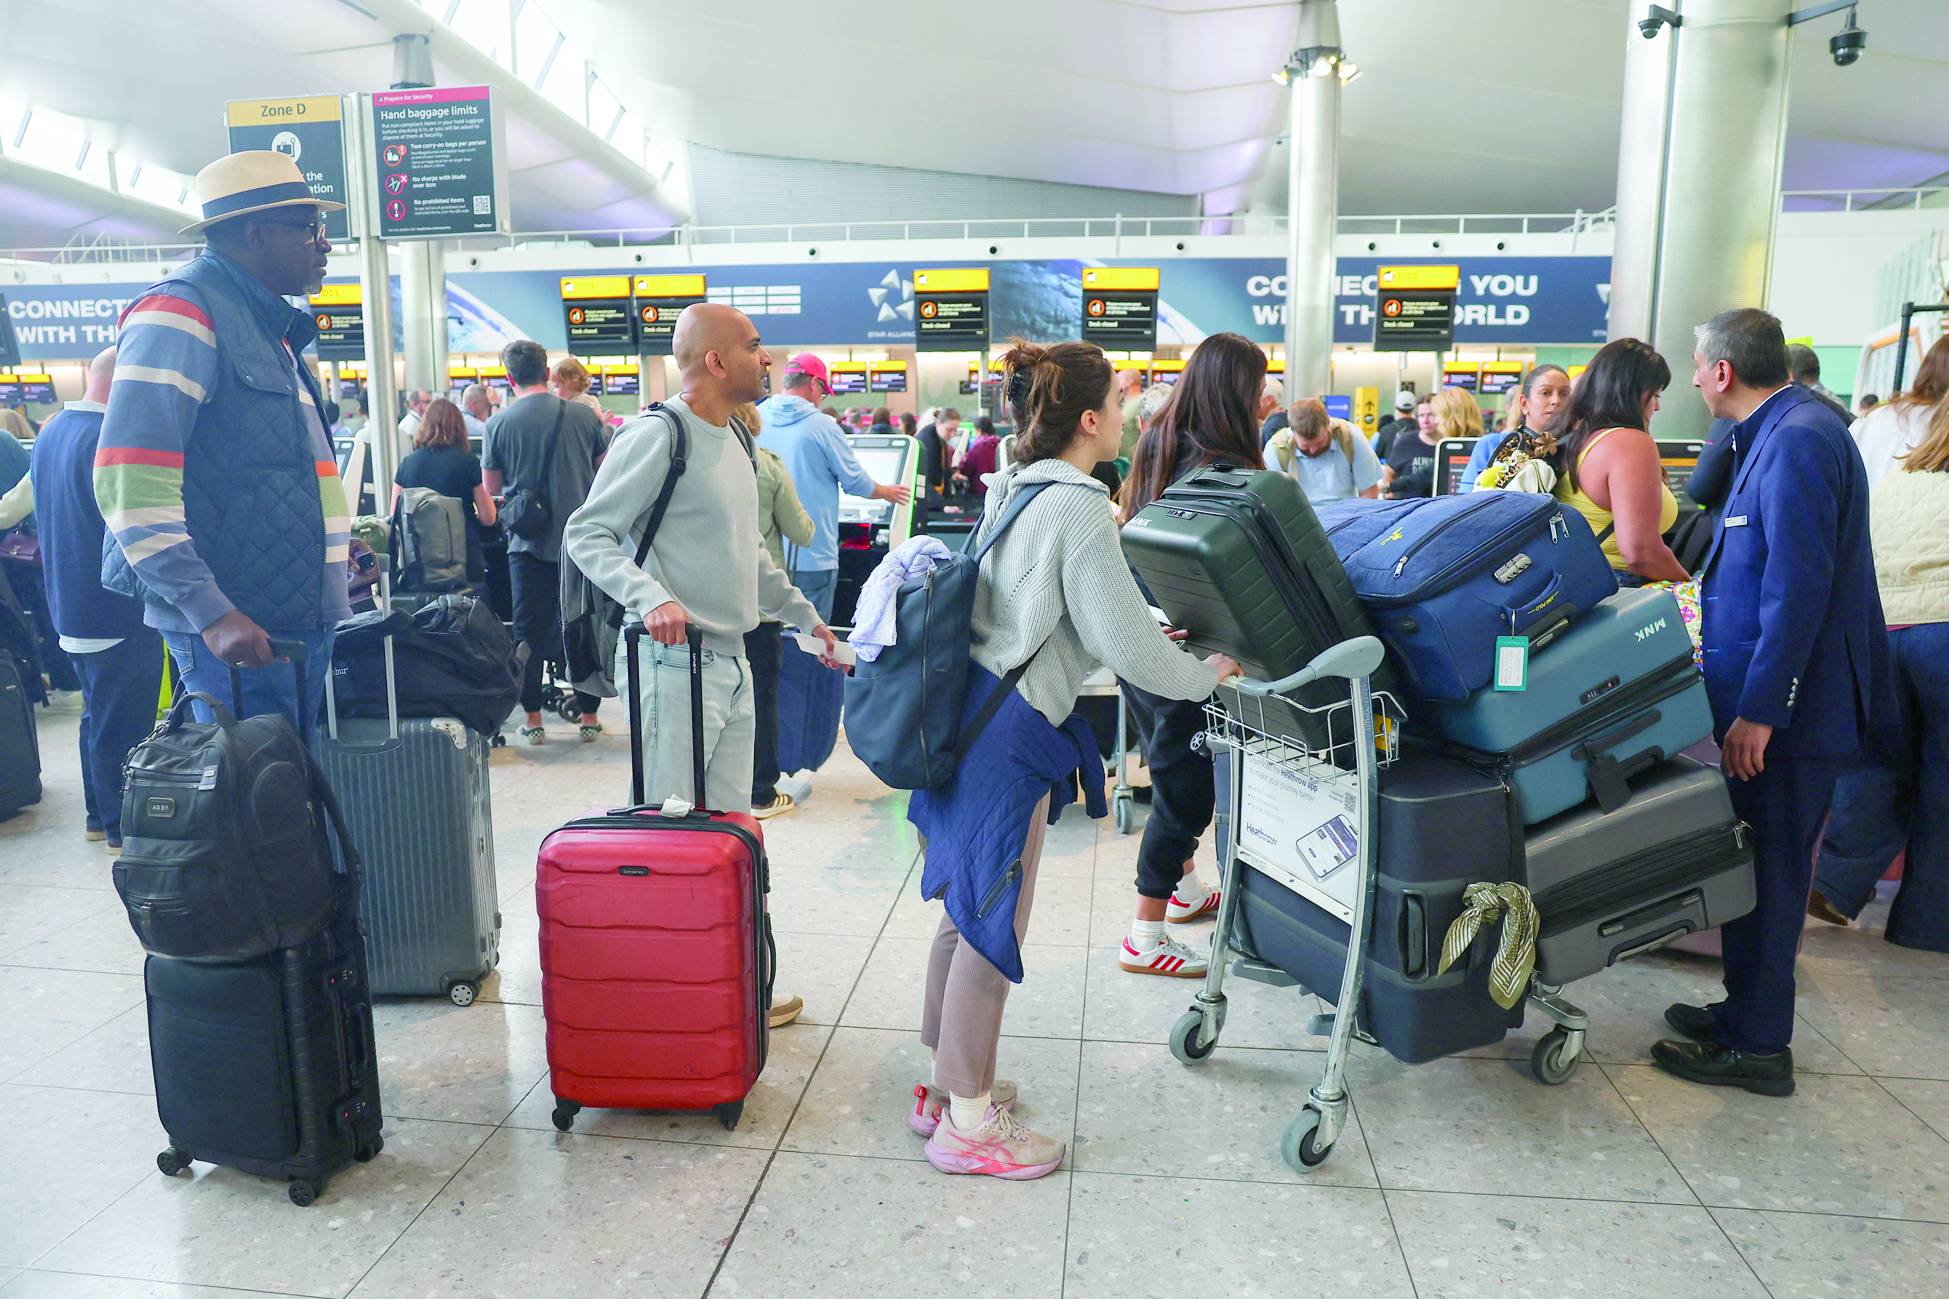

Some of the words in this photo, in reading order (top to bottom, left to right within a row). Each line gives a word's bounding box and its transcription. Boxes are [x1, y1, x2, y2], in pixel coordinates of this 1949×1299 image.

[260, 105, 293, 117] Zone
[297, 103, 306, 115] D
[381, 110, 406, 120] Hand
[408, 106, 449, 120] baggage
[451, 104, 478, 116] limits
[305, 171, 323, 181] the
[1470, 274, 1538, 297] YOU
[1339, 304, 1377, 326] TH
[1453, 304, 1531, 326] RLD
[15, 326, 77, 344] WITH
[81, 324, 119, 343] TH
[887, 330, 917, 338] ALLIANC
[1634, 617, 1667, 642] MNK
[1280, 769, 1307, 787] Heathrow
[1307, 782, 1318, 793] app
[1246, 822, 1278, 846] Heathrow
